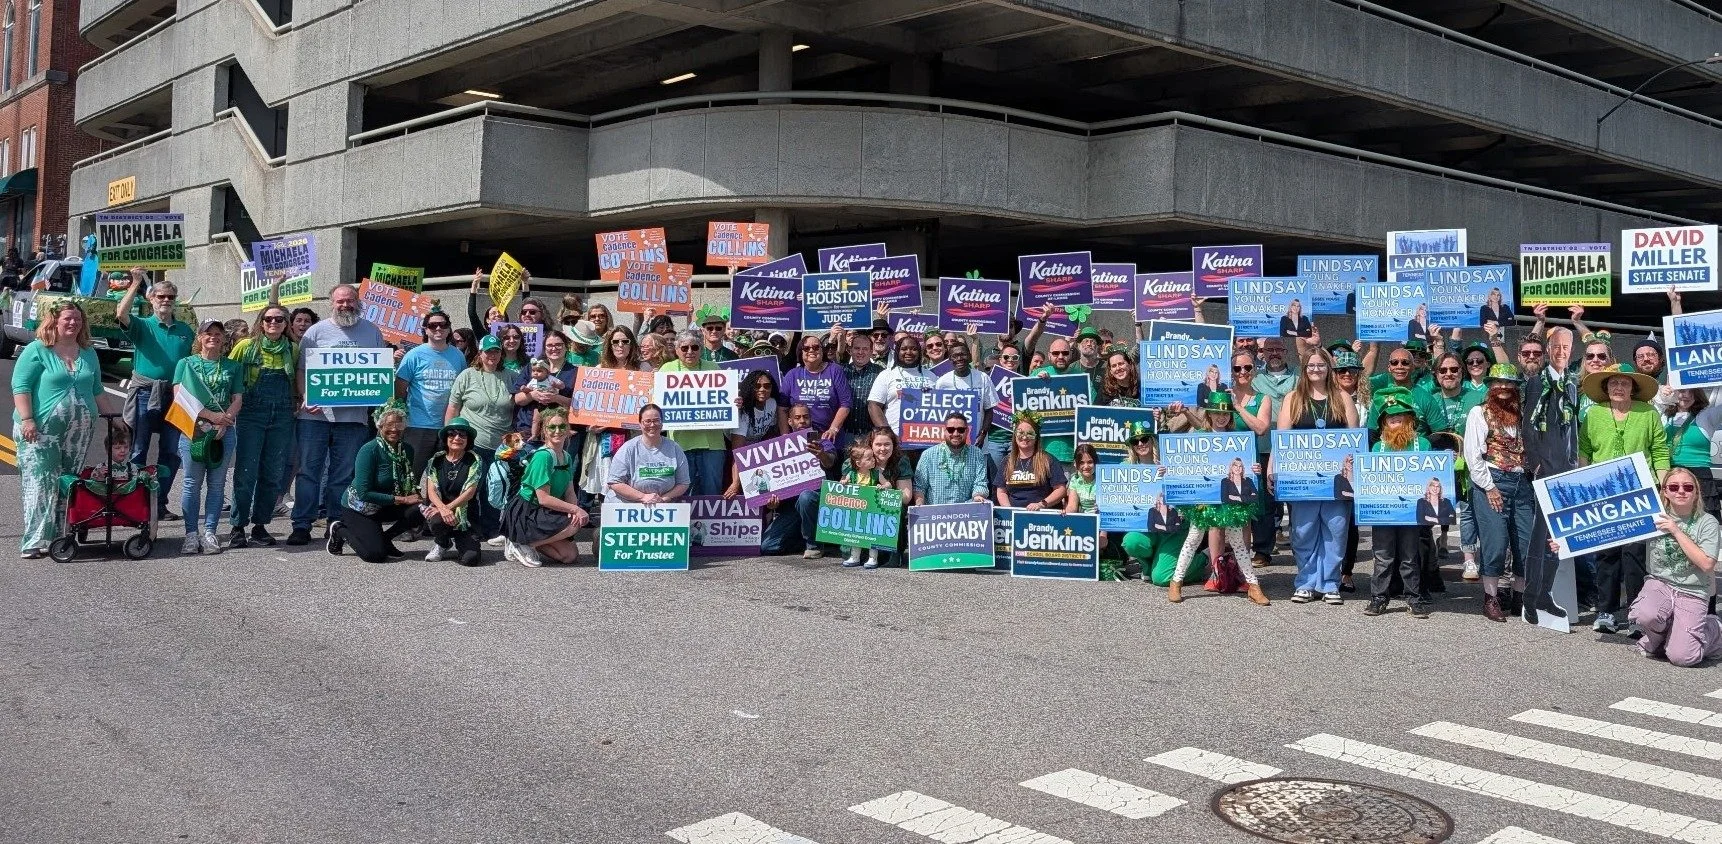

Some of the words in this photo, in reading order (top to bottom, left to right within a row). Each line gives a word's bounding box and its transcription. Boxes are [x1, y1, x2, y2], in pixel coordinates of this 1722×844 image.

[110, 185, 120, 201] EXIT
[121, 181, 134, 199] ONLY
[714, 223, 738, 231] VOTE
[100, 224, 182, 248] MICHAELA
[601, 233, 629, 242] VOTE
[1635, 230, 1704, 249] DAVID
[102, 252, 120, 261] FOR
[123, 244, 183, 260] CONGRESS
[260, 244, 309, 265] MICHAELA
[708, 240, 766, 257] COLLINS
[1201, 252, 1254, 271] Katina
[1394, 256, 1460, 269] LANGAN
[1631, 248, 1708, 267] MILLER
[627, 261, 655, 271] VOTE
[1029, 260, 1083, 280] Katina
[1303, 260, 1373, 272] LINDSAY
[1524, 255, 1607, 281] MICHAELA
[1092, 269, 1129, 284] atina
[1303, 273, 1339, 281] YOUNG
[1430, 269, 1507, 285] LINDSAY
[1632, 271, 1665, 283] STATE
[1667, 270, 1706, 282] SENATE
[244, 292, 259, 303] FOR
[262, 279, 309, 300] COGRESS
[368, 281, 400, 297] VOTE
[740, 282, 795, 301] Katina
[818, 280, 841, 291] BEN
[1143, 279, 1192, 296] Katina
[1234, 281, 1307, 294] LINDSAY
[1312, 282, 1352, 291] ONAKER
[1361, 285, 1425, 299] LINDSA
[1524, 285, 1542, 295] FOR
[1545, 278, 1607, 295] CONGRESS
[619, 281, 688, 304] COLLINS
[806, 290, 869, 305] HOUSTON
[948, 285, 1002, 304] Katina
[1234, 295, 1271, 303] YOUNG
[1362, 300, 1399, 308] YOUNG
[1431, 295, 1487, 304] HONAKER
[1234, 305, 1286, 313] HONAKER
[1362, 309, 1414, 318] HONAKER
[822, 314, 853, 324] JUDGE
[1165, 331, 1191, 341] Brandy
[1146, 344, 1226, 359] LINDSAY
[320, 352, 381, 365] TRUST
[1147, 360, 1187, 369] YOUNG
[310, 373, 390, 386] STEPHEN
[585, 368, 616, 380] VOTE
[1147, 371, 1204, 380] HONAKER
[667, 373, 727, 389] DAVID
[797, 379, 832, 387] VIVIAN
[321, 388, 338, 397] For
[343, 388, 381, 397] Trustee
[801, 387, 830, 396] Shipe
[1026, 386, 1050, 396] Brandy
[663, 390, 730, 406] MILLER
[921, 392, 976, 409] ELECT
[1016, 390, 1088, 411] Jenkins
[665, 411, 692, 421] STATE
[694, 409, 729, 420] SENATE
[903, 408, 973, 423] O'TAVS
[1091, 417, 1116, 426] Brandy
[1078, 422, 1130, 442] Jenki
[1166, 437, 1250, 454] LINDSAY
[1278, 433, 1363, 450] LINDSAY
[736, 434, 808, 468] VIVIAN
[1279, 451, 1322, 460] YOUNG
[1166, 454, 1209, 464] YOUNG
[1360, 456, 1448, 473] LINDSAY
[771, 457, 820, 479] Shipe
[1167, 465, 1227, 476] HONAKER
[1280, 462, 1339, 472] HONAKER
[1360, 474, 1405, 484] YOUNG
[827, 482, 860, 496] VOTE
[880, 491, 900, 500] She's
[1101, 485, 1139, 493] YOUNG
[1361, 485, 1423, 495] HONAKER
[880, 499, 902, 508] Irish!
[1101, 495, 1154, 505] HONAKER
[615, 508, 678, 523] TRUST
[931, 513, 970, 521] BRANDON
[1556, 494, 1652, 533] LANGAN
[818, 506, 898, 538] COLLINS
[1028, 523, 1055, 534] Brandy
[710, 522, 760, 539] Shipe
[914, 520, 989, 545] HUCKABY
[1574, 528, 1617, 543] TENNESSEE
[1618, 519, 1646, 532] SENATE
[604, 533, 686, 547] STEPHEN
[1015, 529, 1095, 552] Jenkins
[918, 543, 943, 551] COUNTY
[614, 550, 633, 560] For
[635, 550, 675, 560] Trustee
